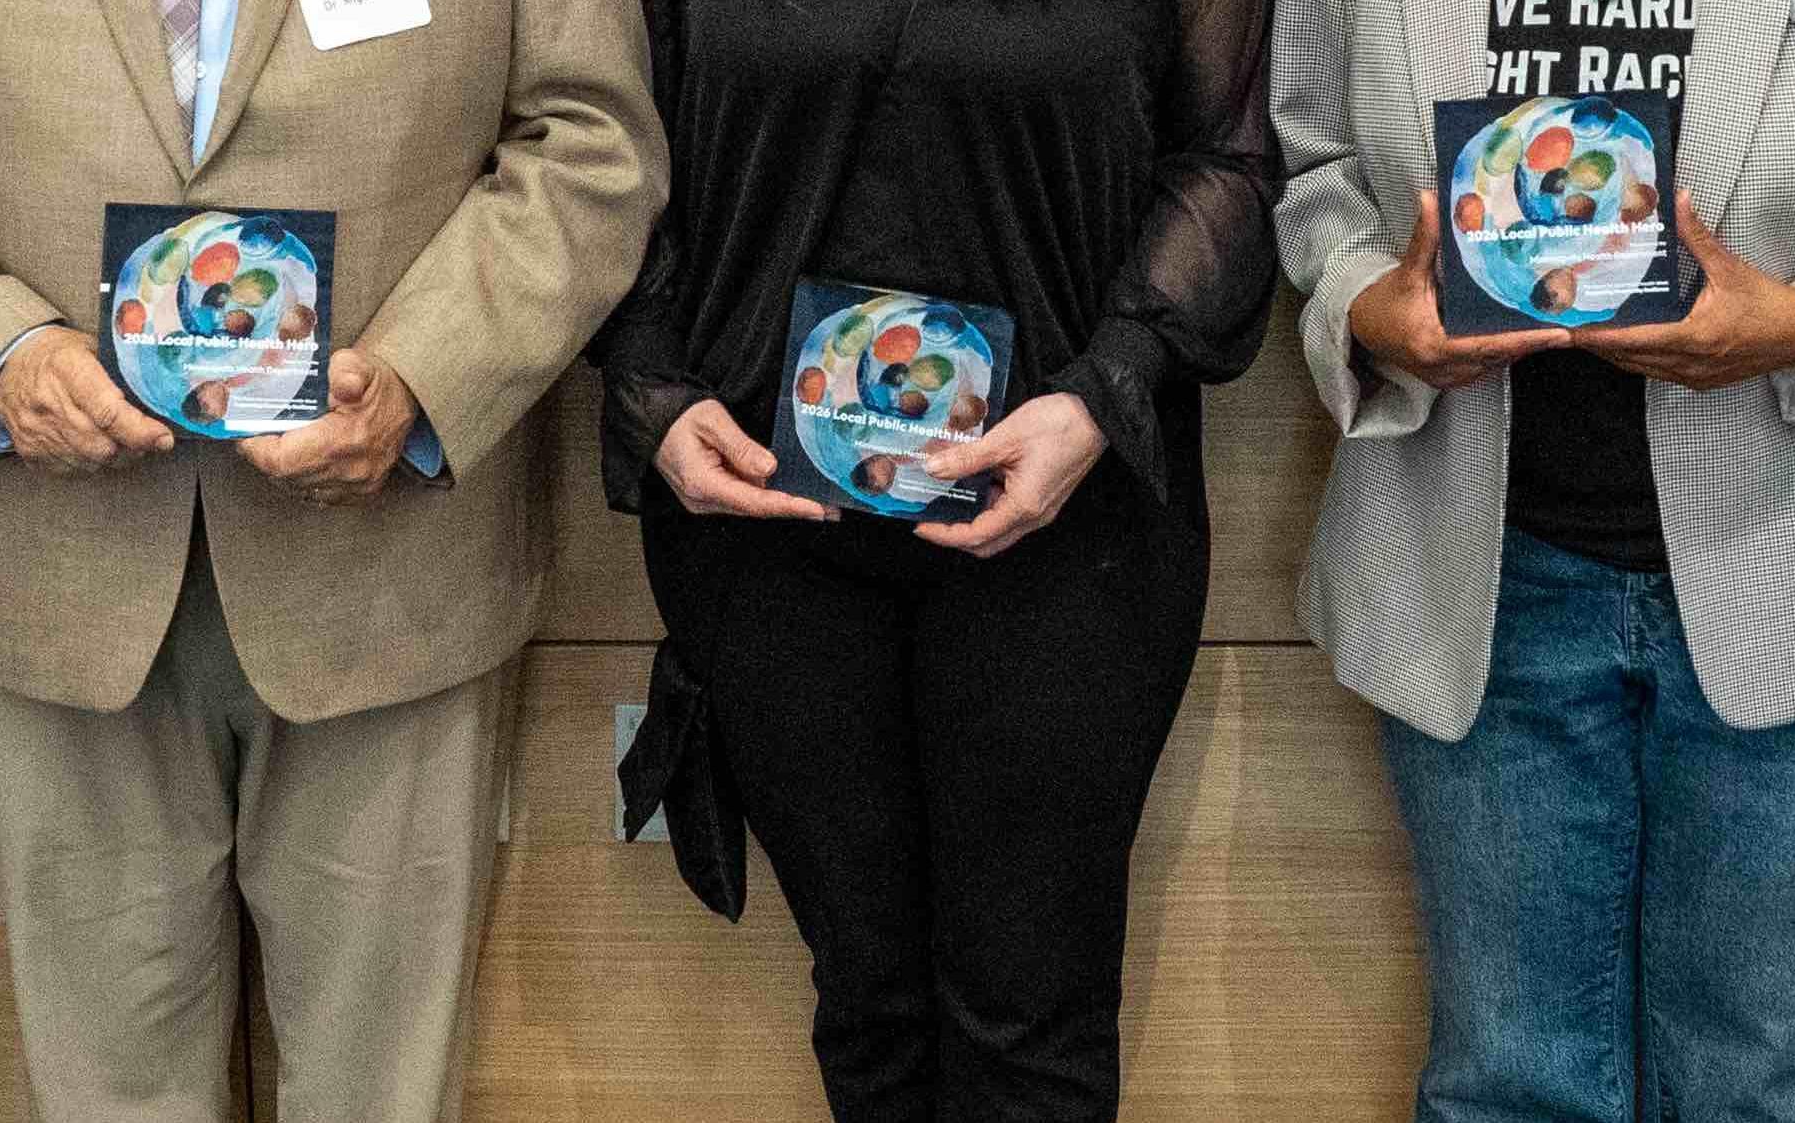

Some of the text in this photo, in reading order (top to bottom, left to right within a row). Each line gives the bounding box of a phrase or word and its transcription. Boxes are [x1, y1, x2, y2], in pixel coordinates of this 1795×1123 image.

[1578, 46, 1693, 98] RAC
[1501, 228, 1537, 241] Local
[1539, 224, 1581, 239] Public
[1582, 222, 1629, 237] Health
[1631, 221, 1665, 234] Hero
[158, 333, 193, 346] Local
[195, 335, 237, 349] Public
[239, 337, 285, 350] Health
[286, 339, 319, 351] Hero
[800, 404, 831, 419] 2026
[833, 409, 867, 425] Local
[868, 415, 906, 432] Public
[909, 422, 952, 440] Health
